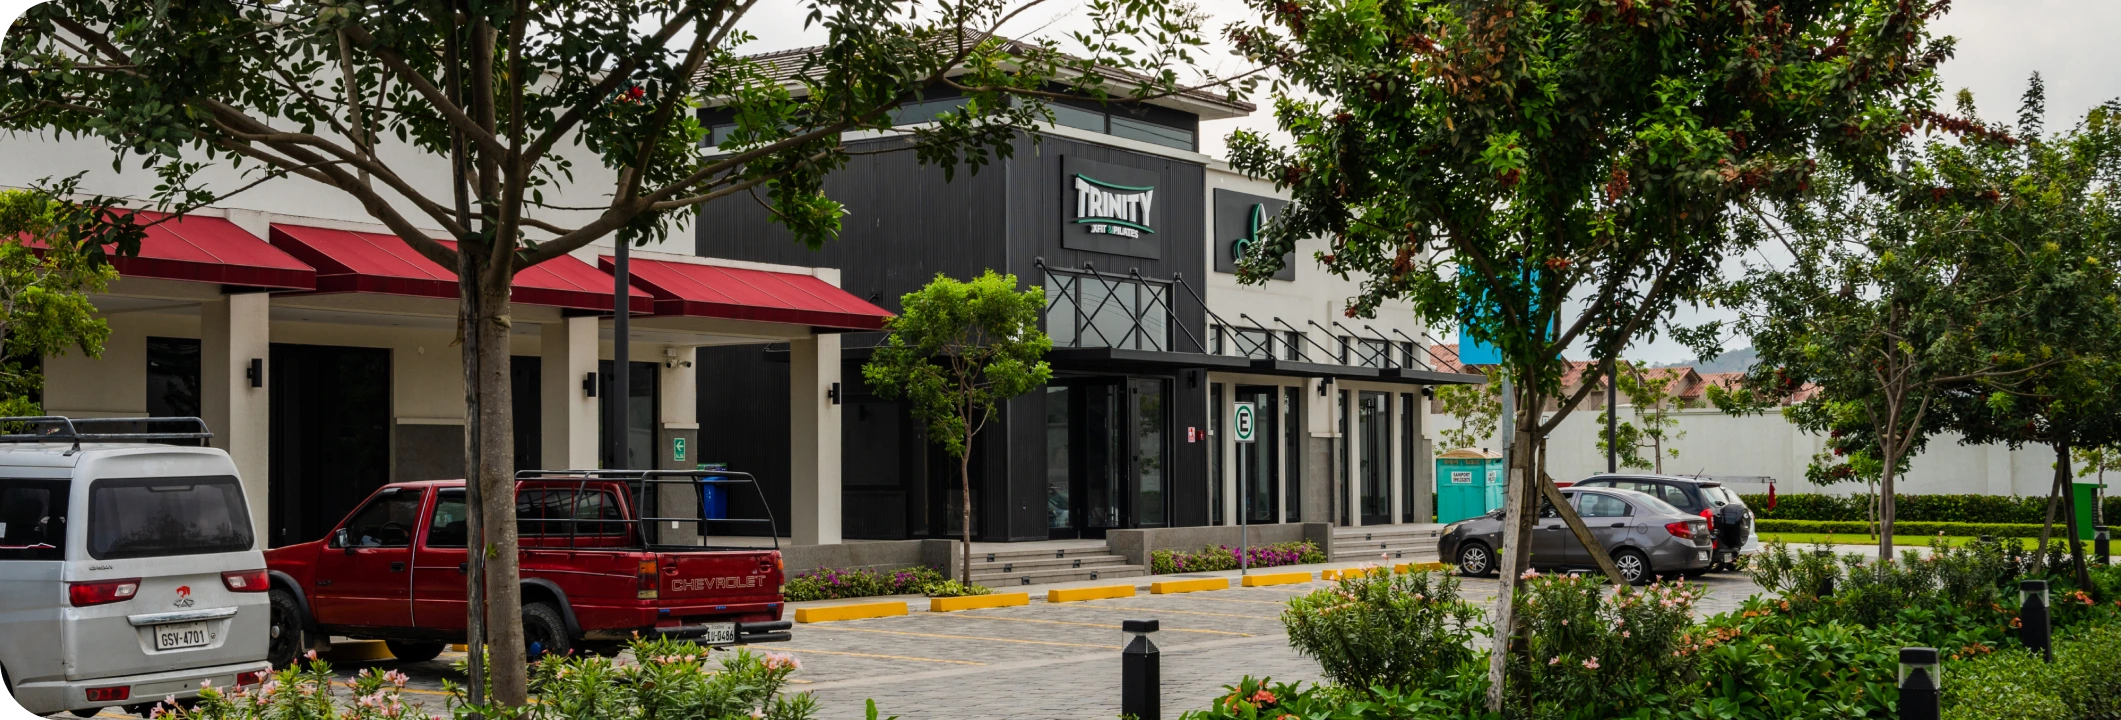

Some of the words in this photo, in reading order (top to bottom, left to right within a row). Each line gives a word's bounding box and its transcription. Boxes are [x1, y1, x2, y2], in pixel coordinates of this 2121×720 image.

[1075, 177, 1153, 227] TRINITY
[1090, 224, 1107, 233] XFIT
[1112, 226, 1139, 239] PILATES
[1240, 413, 1248, 432] E
[672, 575, 766, 591] CHEVROLET
[161, 630, 204, 647] GSV-4701
[707, 630, 734, 642] IU-0486
